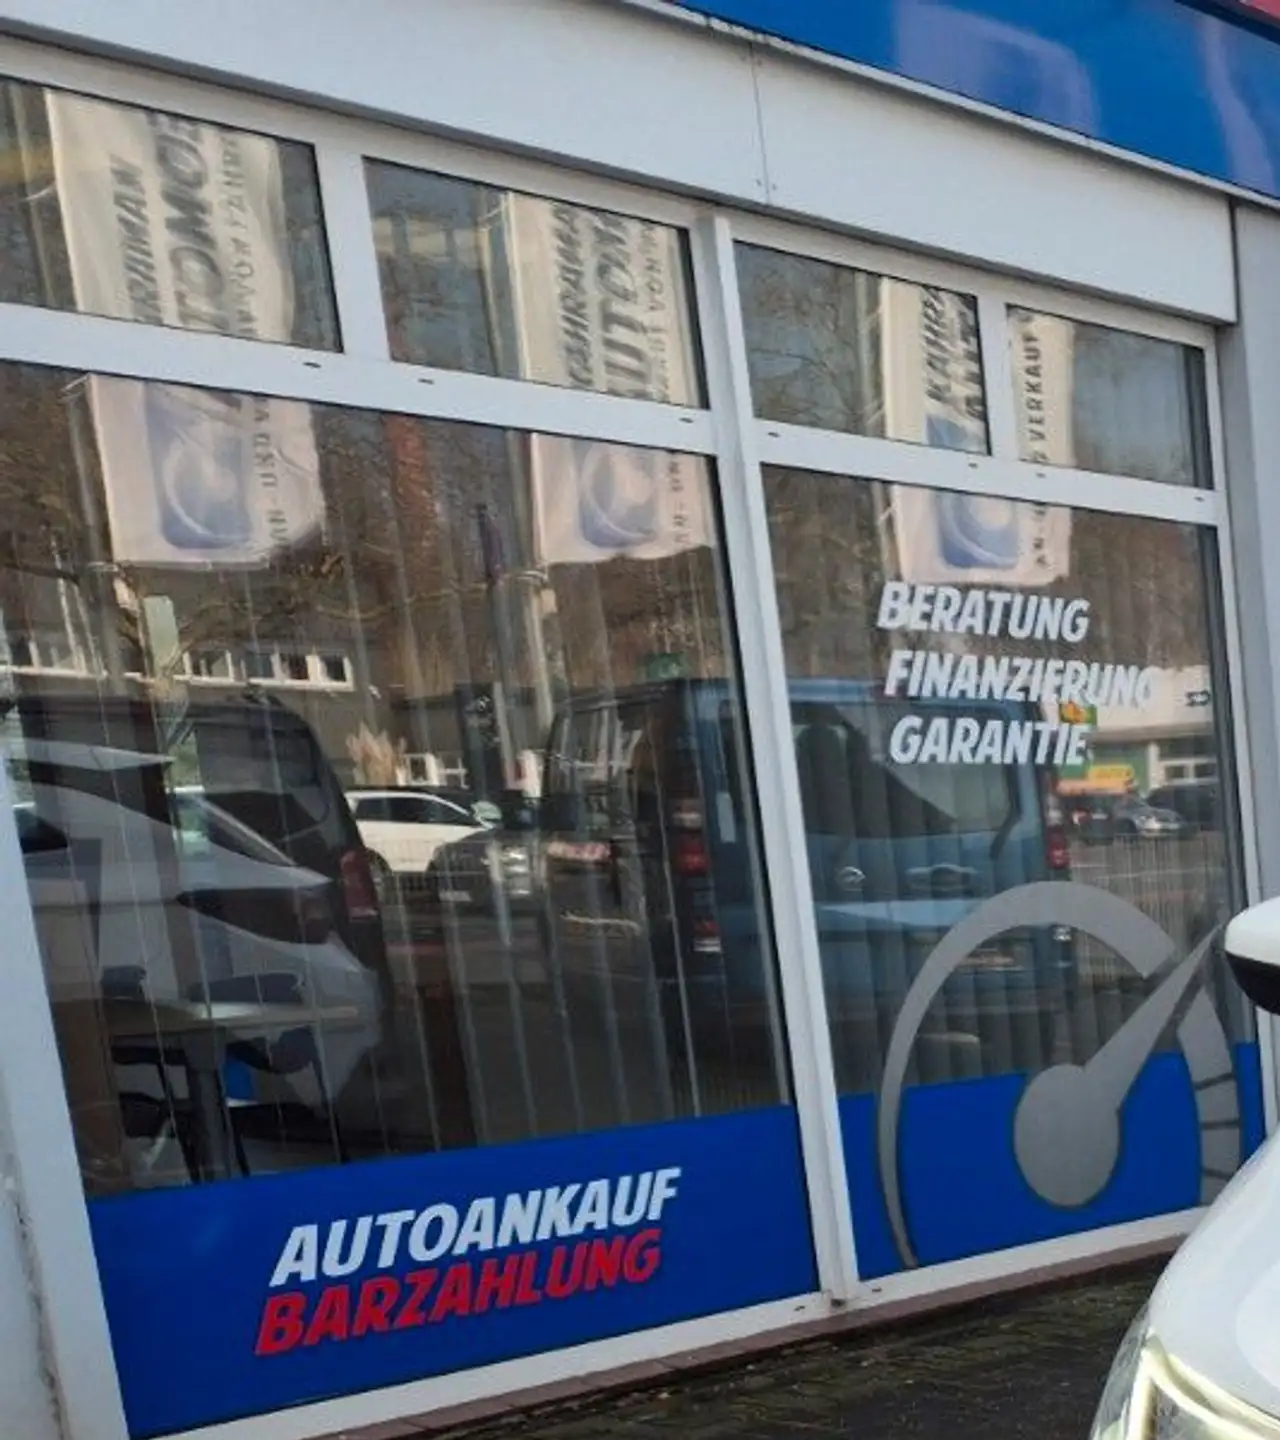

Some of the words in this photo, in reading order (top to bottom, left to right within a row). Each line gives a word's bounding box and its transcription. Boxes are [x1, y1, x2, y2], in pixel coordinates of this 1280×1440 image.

[876, 580, 1092, 643] BERATUNG
[884, 649, 1155, 713] FINANZIERUNG
[889, 714, 1090, 766] GARANTIE
[269, 1166, 681, 1288] AUTOANKAUF
[254, 1227, 663, 1357] BARZAHLUNG
